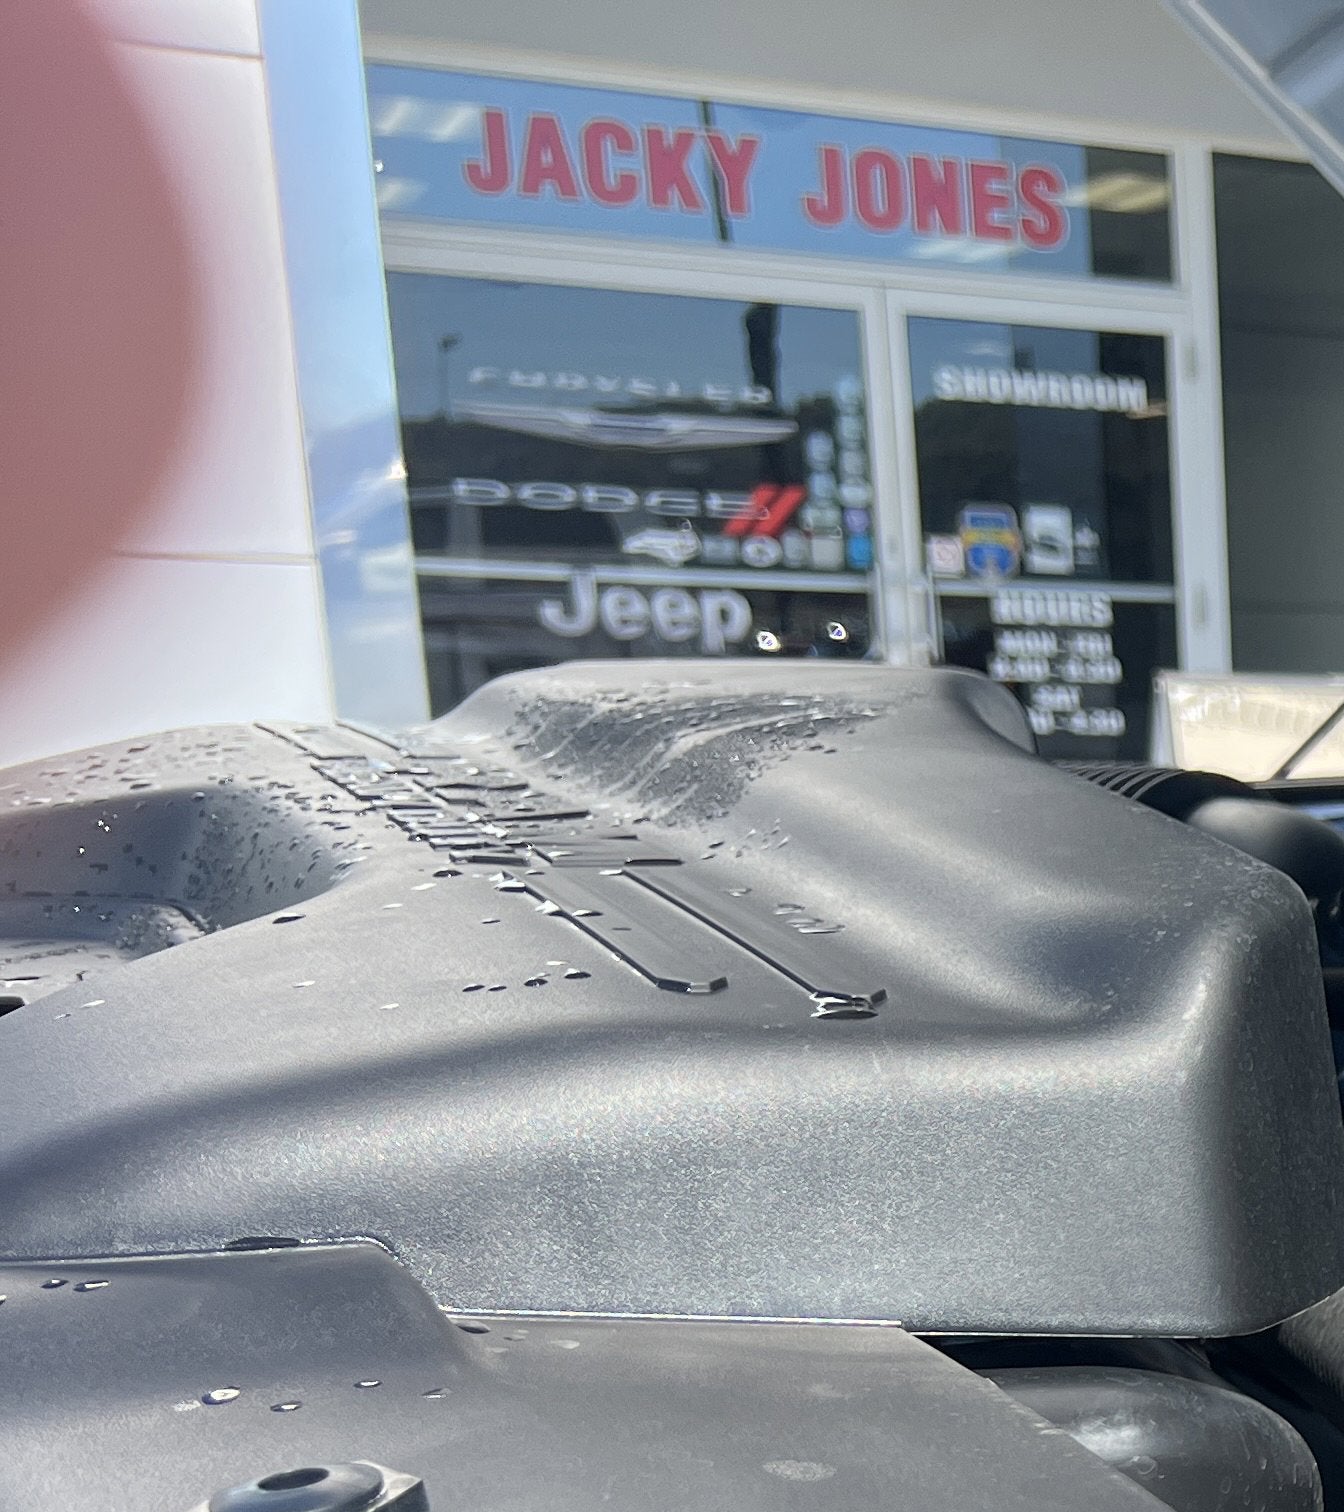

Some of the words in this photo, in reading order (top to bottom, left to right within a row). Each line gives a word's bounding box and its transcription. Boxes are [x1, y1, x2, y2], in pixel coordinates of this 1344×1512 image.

[464, 107, 759, 216] JACKY
[805, 144, 1069, 249] JONES
[932, 365, 1148, 413] SHOWROOM
[537, 569, 753, 654] Jeep
